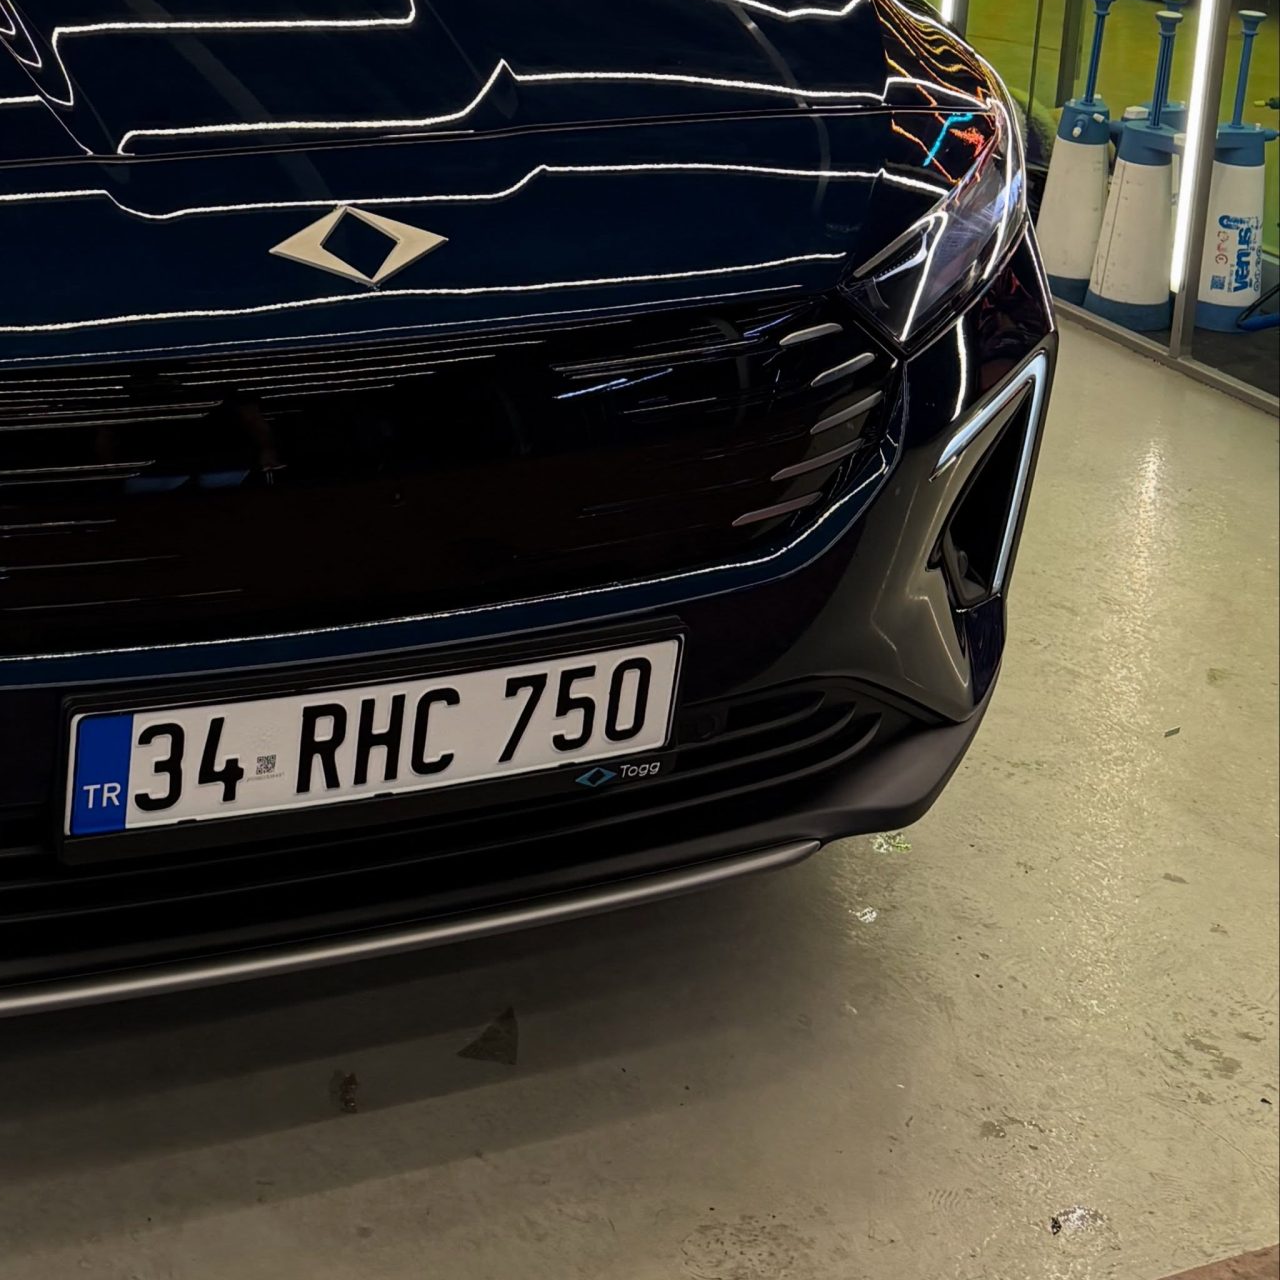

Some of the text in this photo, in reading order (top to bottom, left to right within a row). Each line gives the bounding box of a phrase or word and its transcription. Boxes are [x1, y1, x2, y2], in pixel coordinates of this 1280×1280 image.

[134, 657, 652, 811] 34 RHC 750
[620, 761, 660, 778] Togg
[83, 782, 121, 809] TR
